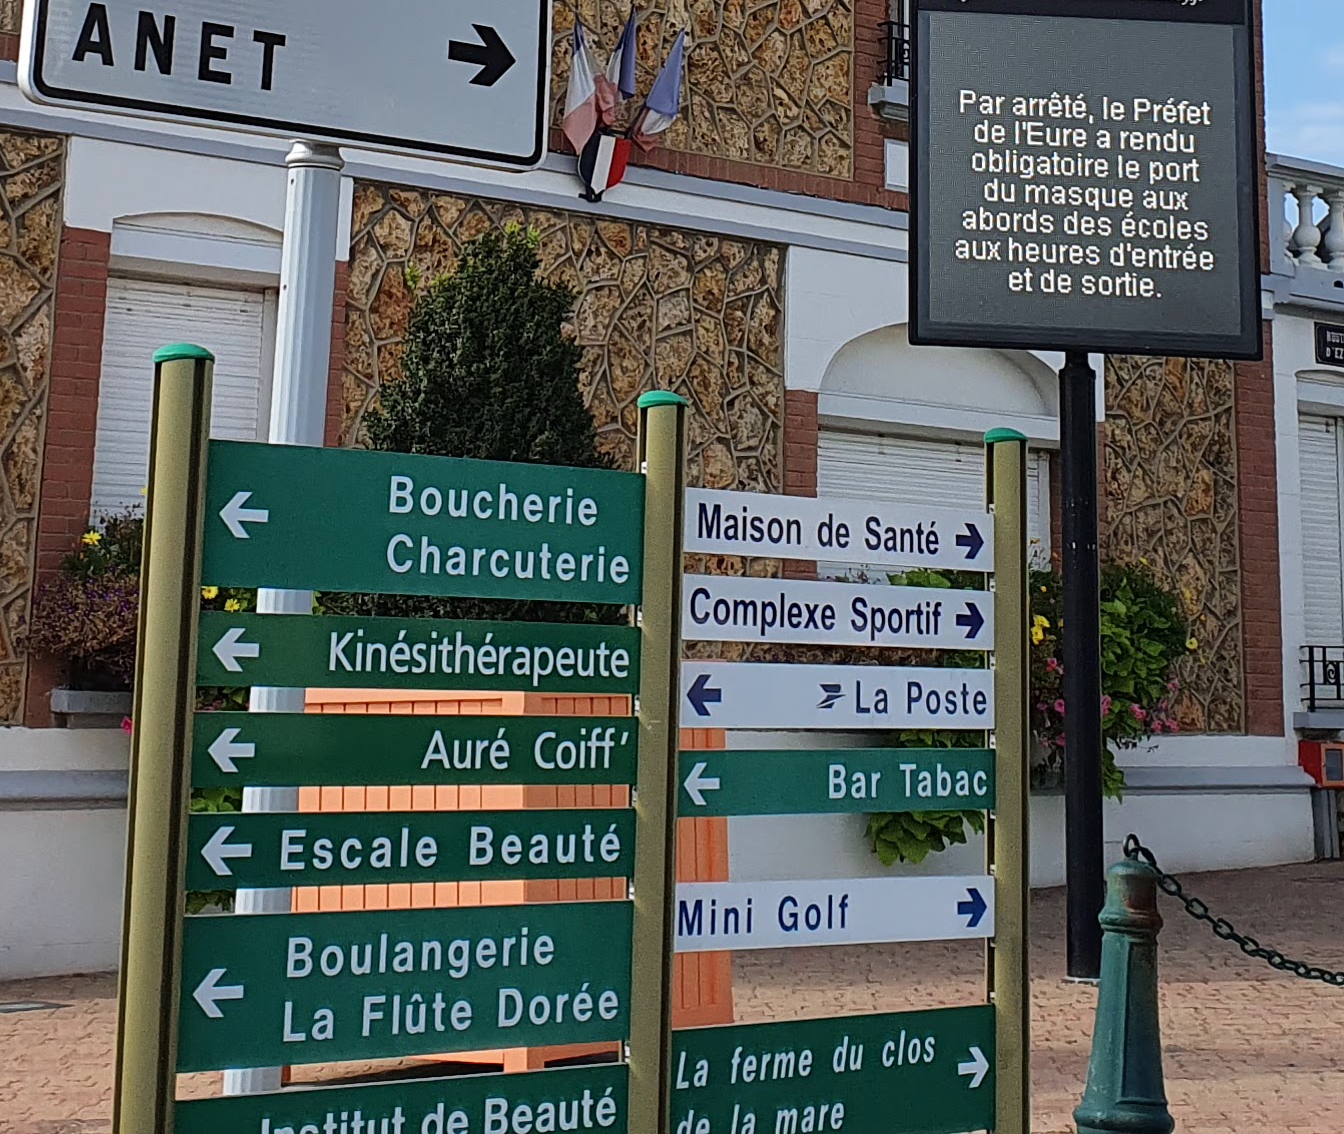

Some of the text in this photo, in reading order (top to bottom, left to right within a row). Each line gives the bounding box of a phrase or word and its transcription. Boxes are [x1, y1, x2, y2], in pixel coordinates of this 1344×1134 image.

[71, 1, 287, 91] ANET
[959, 89, 1211, 126] Par arrêté, le Préfet
[973, 119, 1195, 154] de l'Eure a rendu
[971, 148, 1200, 185] obligatoire le port
[983, 177, 1189, 212] du masque aux
[962, 206, 1209, 241] abords des écoles
[955, 237, 1214, 271] aux heures d'entrée
[1007, 267, 1162, 298] et de sortie.
[388, 475, 599, 526] Boucherie
[697, 502, 939, 555] Maison de Santé
[386, 533, 630, 584] Charcuterie
[689, 587, 943, 641] Complexe Sportif
[328, 629, 630, 686] Kinésithérapeute
[855, 679, 988, 716] La Poste
[420, 726, 629, 770] Auré Coiff'
[828, 762, 988, 800] Bar Tabac
[279, 823, 622, 871] Escale Beauté
[677, 893, 849, 937] Mini Golf
[286, 926, 555, 979] Boulangerie
[282, 982, 619, 1043] La Flûte Dorée
[675, 1029, 936, 1090] La ferme du clos
[421, 1102, 469, 1134] de
[484, 1086, 617, 1134] Beauté
[730, 1103, 756, 1134] la
[774, 1102, 845, 1134] mare
